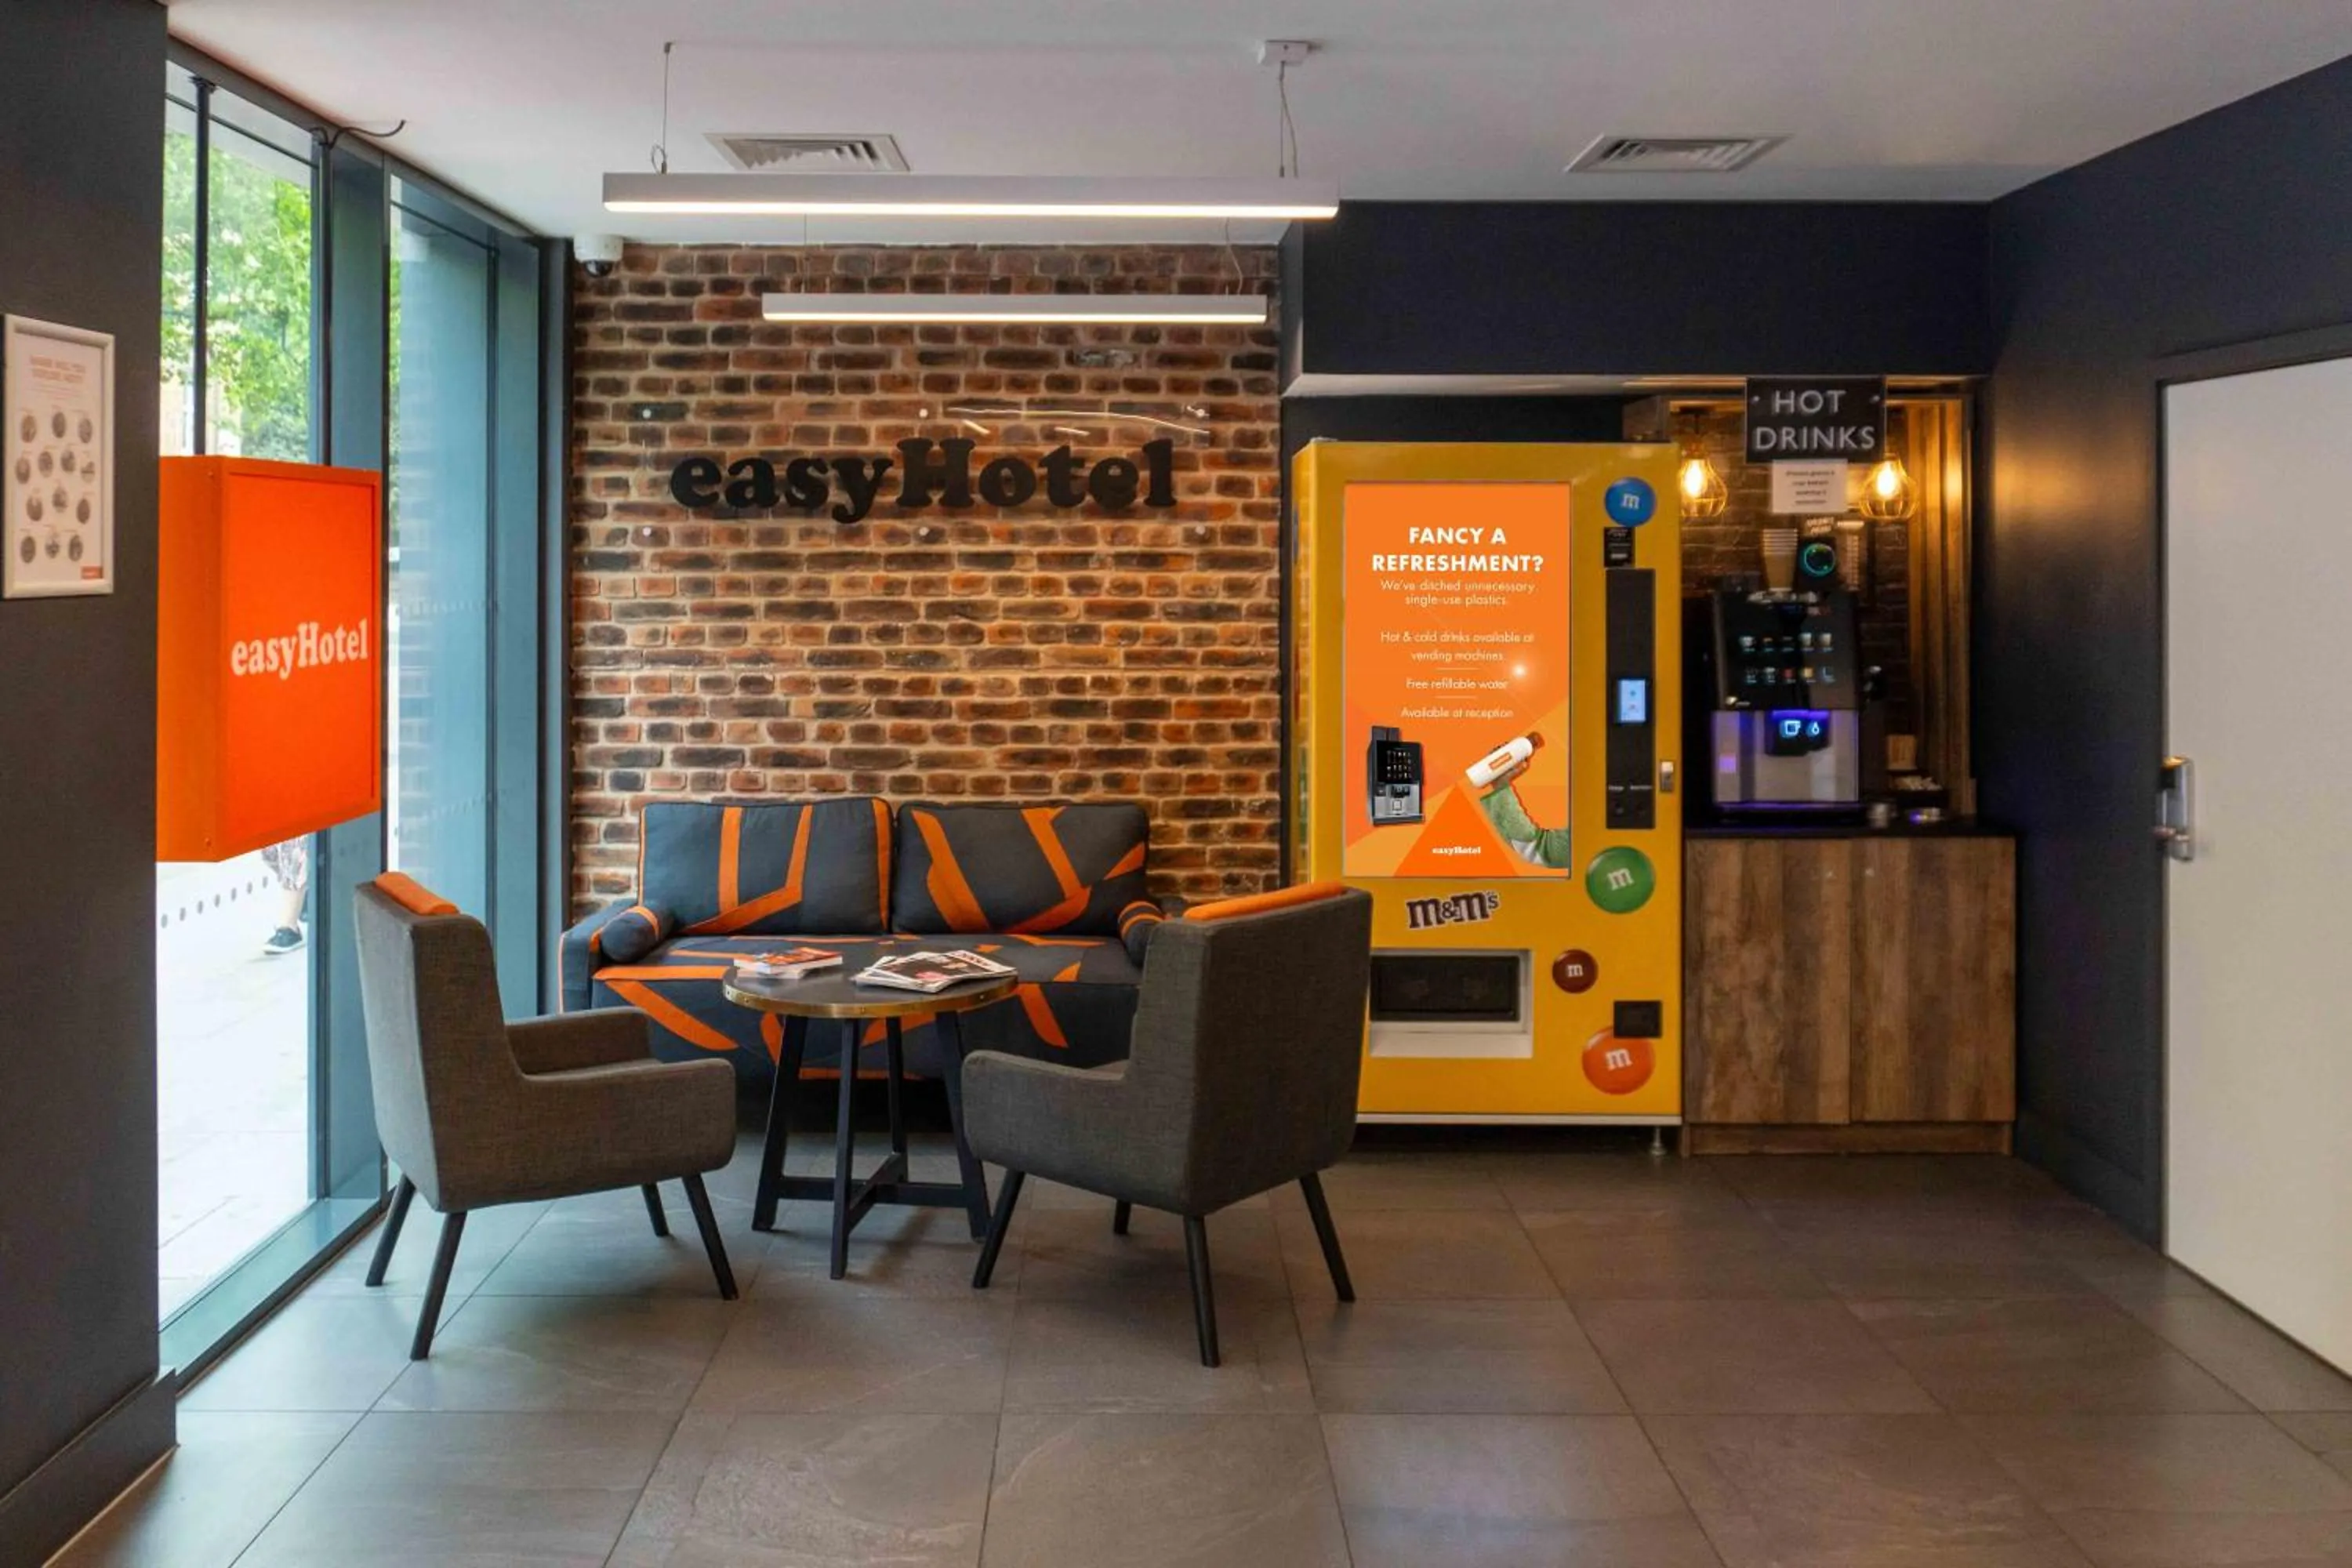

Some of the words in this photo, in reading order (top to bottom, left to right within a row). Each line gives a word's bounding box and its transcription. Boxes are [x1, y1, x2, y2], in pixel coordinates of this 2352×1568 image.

[1773, 390, 1846, 413] HOT
[1753, 426, 1875, 450] DRINKS
[670, 437, 1178, 524] easyHotel
[1409, 527, 1484, 544] FANCY
[1491, 528, 1506, 544] A
[1372, 554, 1544, 572] REFRESHMENT?
[1381, 579, 1415, 590] We've
[1420, 579, 1461, 590] ditched
[1465, 583, 1535, 593] unnecessary
[1381, 631, 1399, 643] Hot
[1403, 631, 1412, 643] &
[1414, 631, 1437, 643] cold
[1440, 630, 1470, 643] drinks
[1473, 630, 1521, 643] available
[1523, 633, 1534, 643] at
[230, 618, 368, 681] easyHotel
[1412, 649, 1452, 662] vending
[1406, 678, 1428, 689] Free
[1431, 677, 1476, 689] refillable
[1479, 680, 1508, 689] water
[1400, 707, 1450, 718] Available
[1452, 708, 1463, 718] at
[1465, 707, 1514, 720] reception
[1432, 846, 1481, 856] easyHotel
